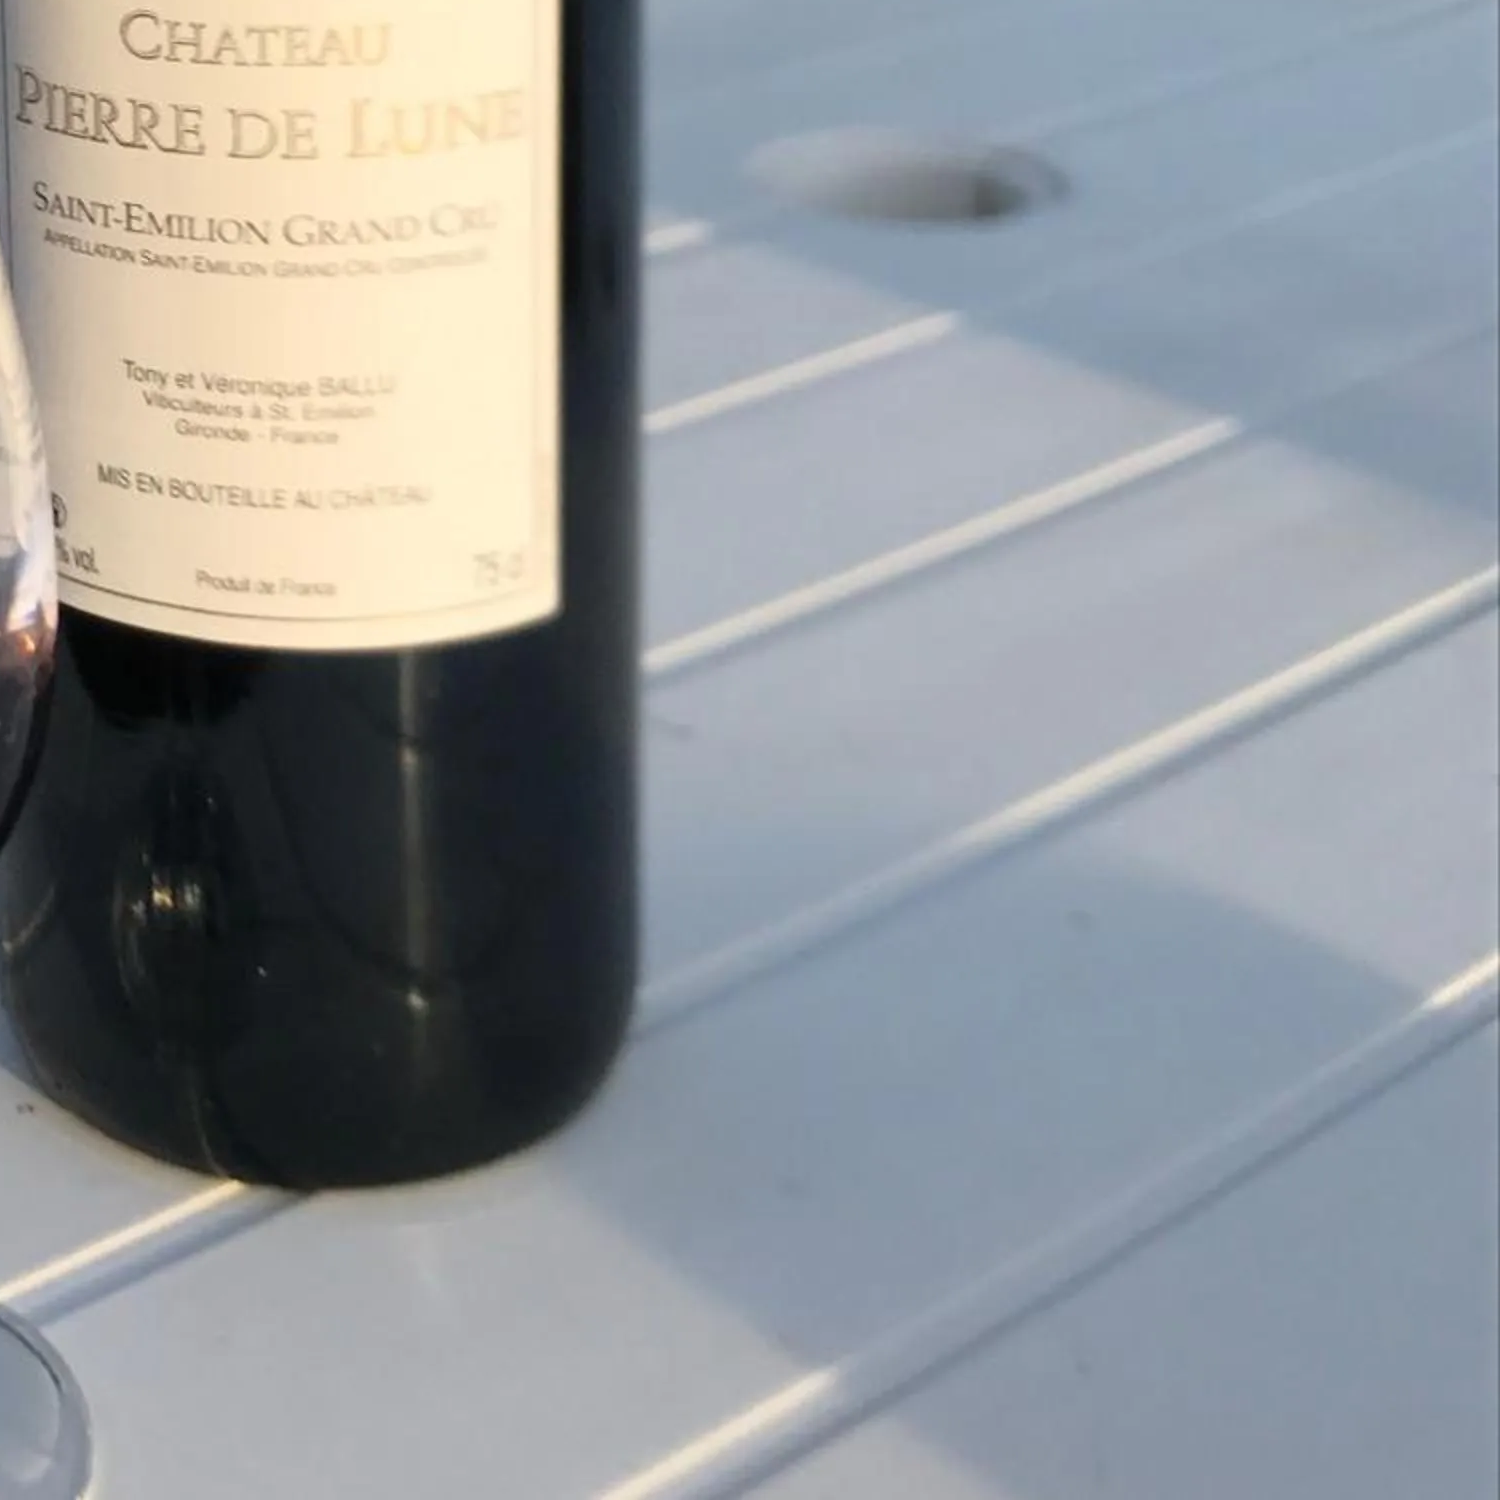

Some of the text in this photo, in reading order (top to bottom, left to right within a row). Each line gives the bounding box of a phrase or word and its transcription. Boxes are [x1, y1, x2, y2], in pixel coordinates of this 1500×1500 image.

[118, 9, 394, 68] CHATEAU
[13, 64, 524, 161] PIERRE DE LUNE
[33, 180, 270, 247] SAINT-EMILION
[283, 212, 422, 248] GRAND
[43, 227, 136, 264] APPELLATION
[122, 358, 169, 388] Tony
[175, 372, 196, 390] et
[174, 417, 250, 444] Gironde
[269, 425, 340, 445] France
[97, 461, 132, 490] MIS
[135, 471, 165, 496] EN
[168, 477, 288, 510] BOUTEILLE
[293, 487, 322, 511] AU
[195, 568, 250, 593] Produit
